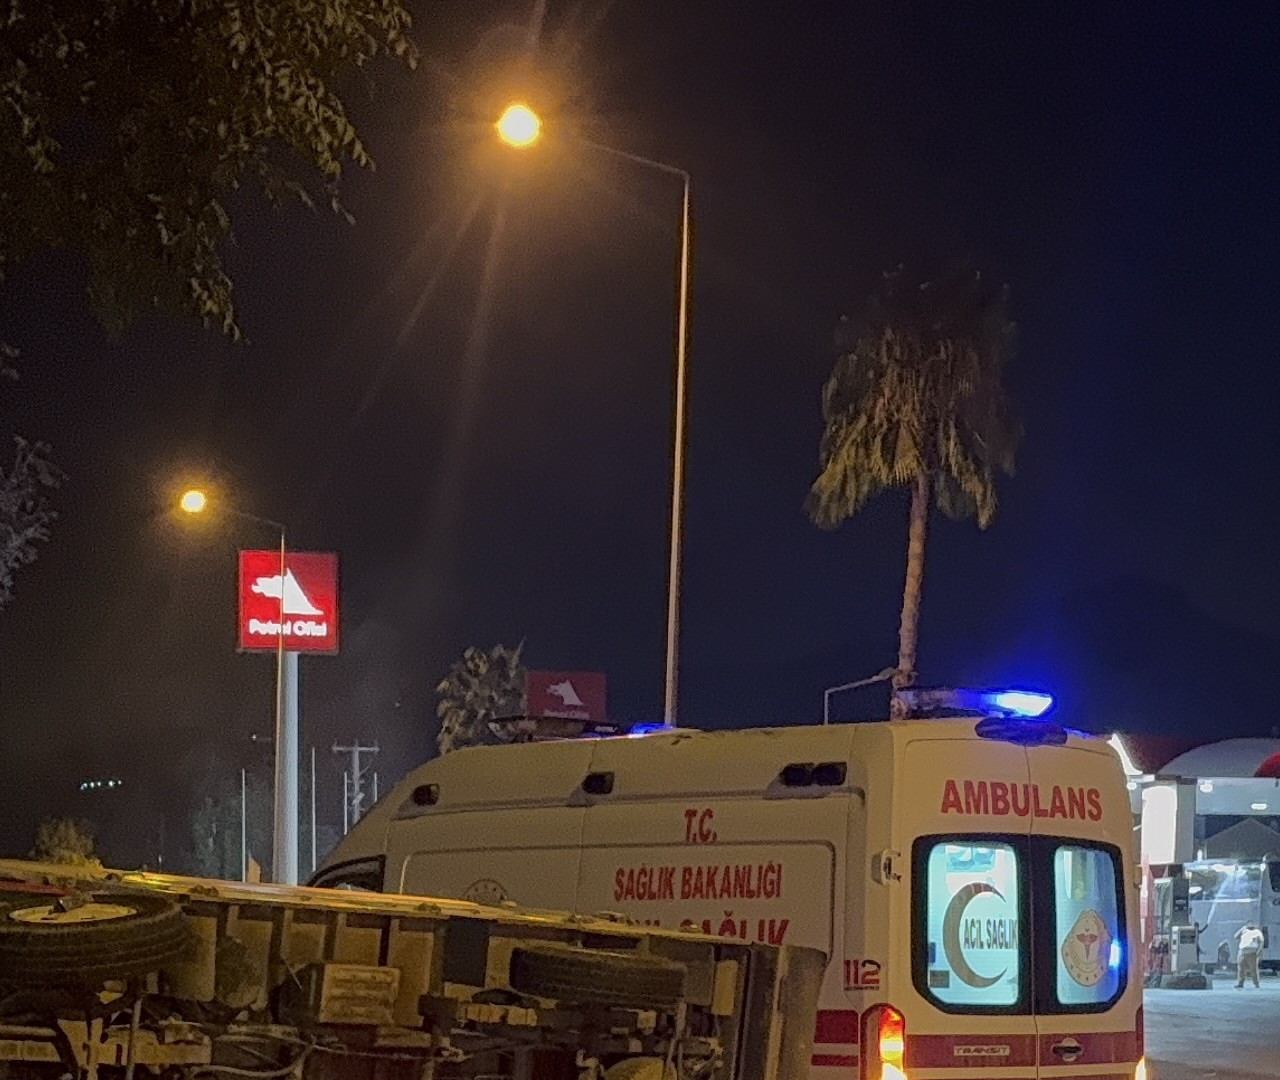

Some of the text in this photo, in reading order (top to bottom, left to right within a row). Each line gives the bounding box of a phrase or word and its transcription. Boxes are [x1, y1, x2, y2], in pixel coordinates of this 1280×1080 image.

[940, 779, 1103, 821] AMBULANS
[684, 808, 718, 844] T.C.
[614, 861, 782, 901] SAĞLIK BAKANLIĞI
[844, 959, 881, 986] 112
